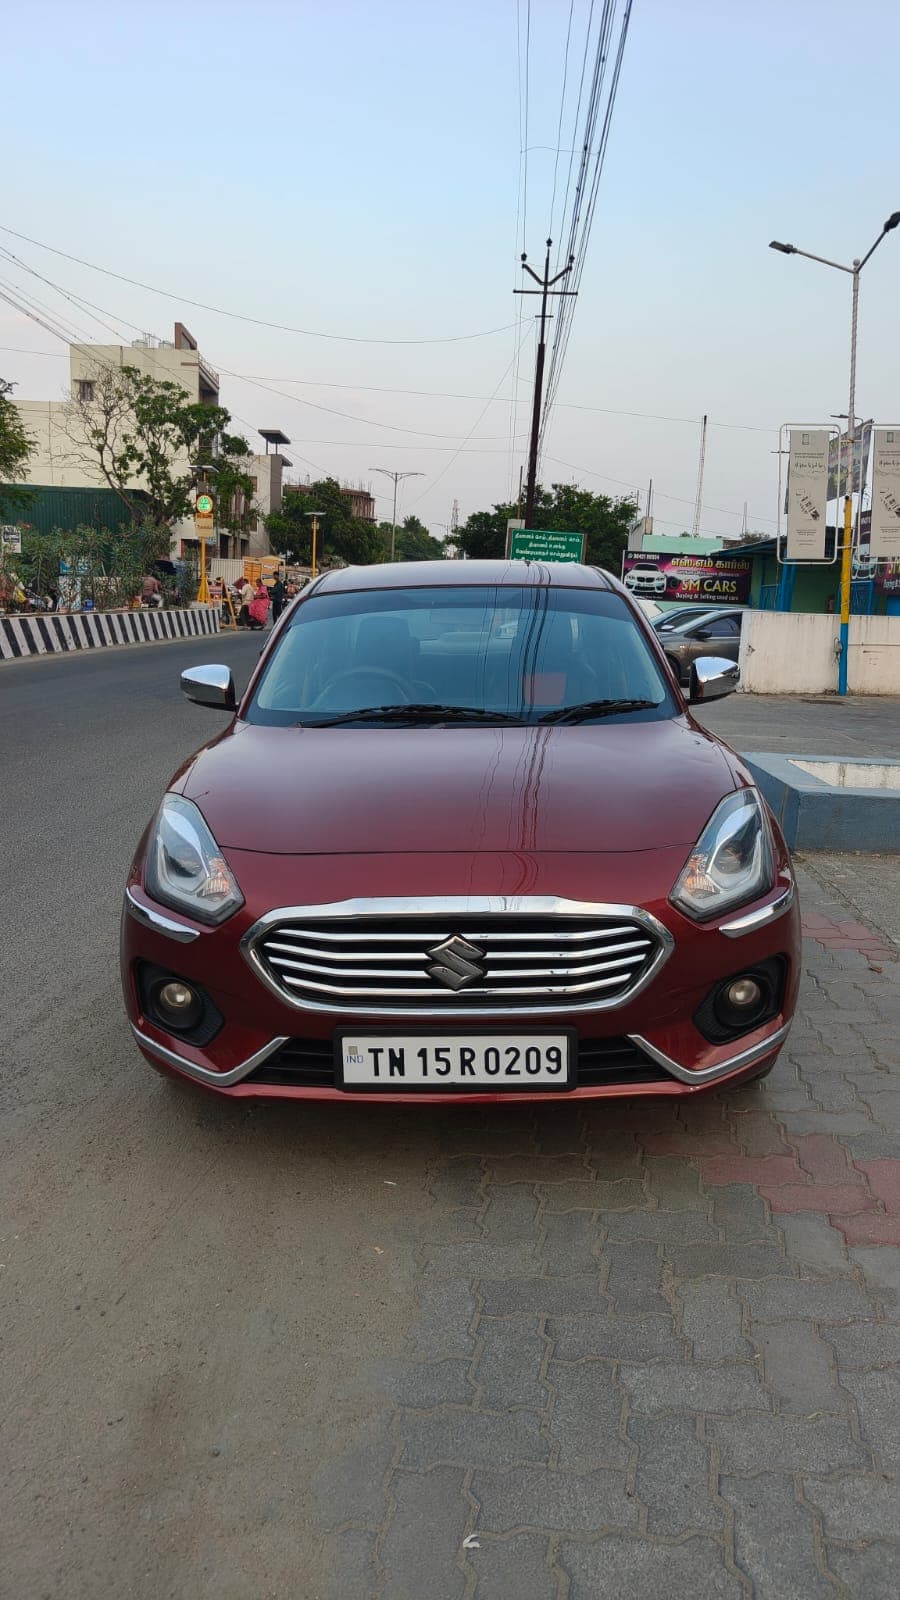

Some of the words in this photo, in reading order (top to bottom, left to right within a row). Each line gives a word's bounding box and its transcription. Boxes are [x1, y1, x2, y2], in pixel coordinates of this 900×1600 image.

[681, 579, 700, 592] SM
[703, 580, 737, 593] CARS
[367, 1047, 406, 1077] TN
